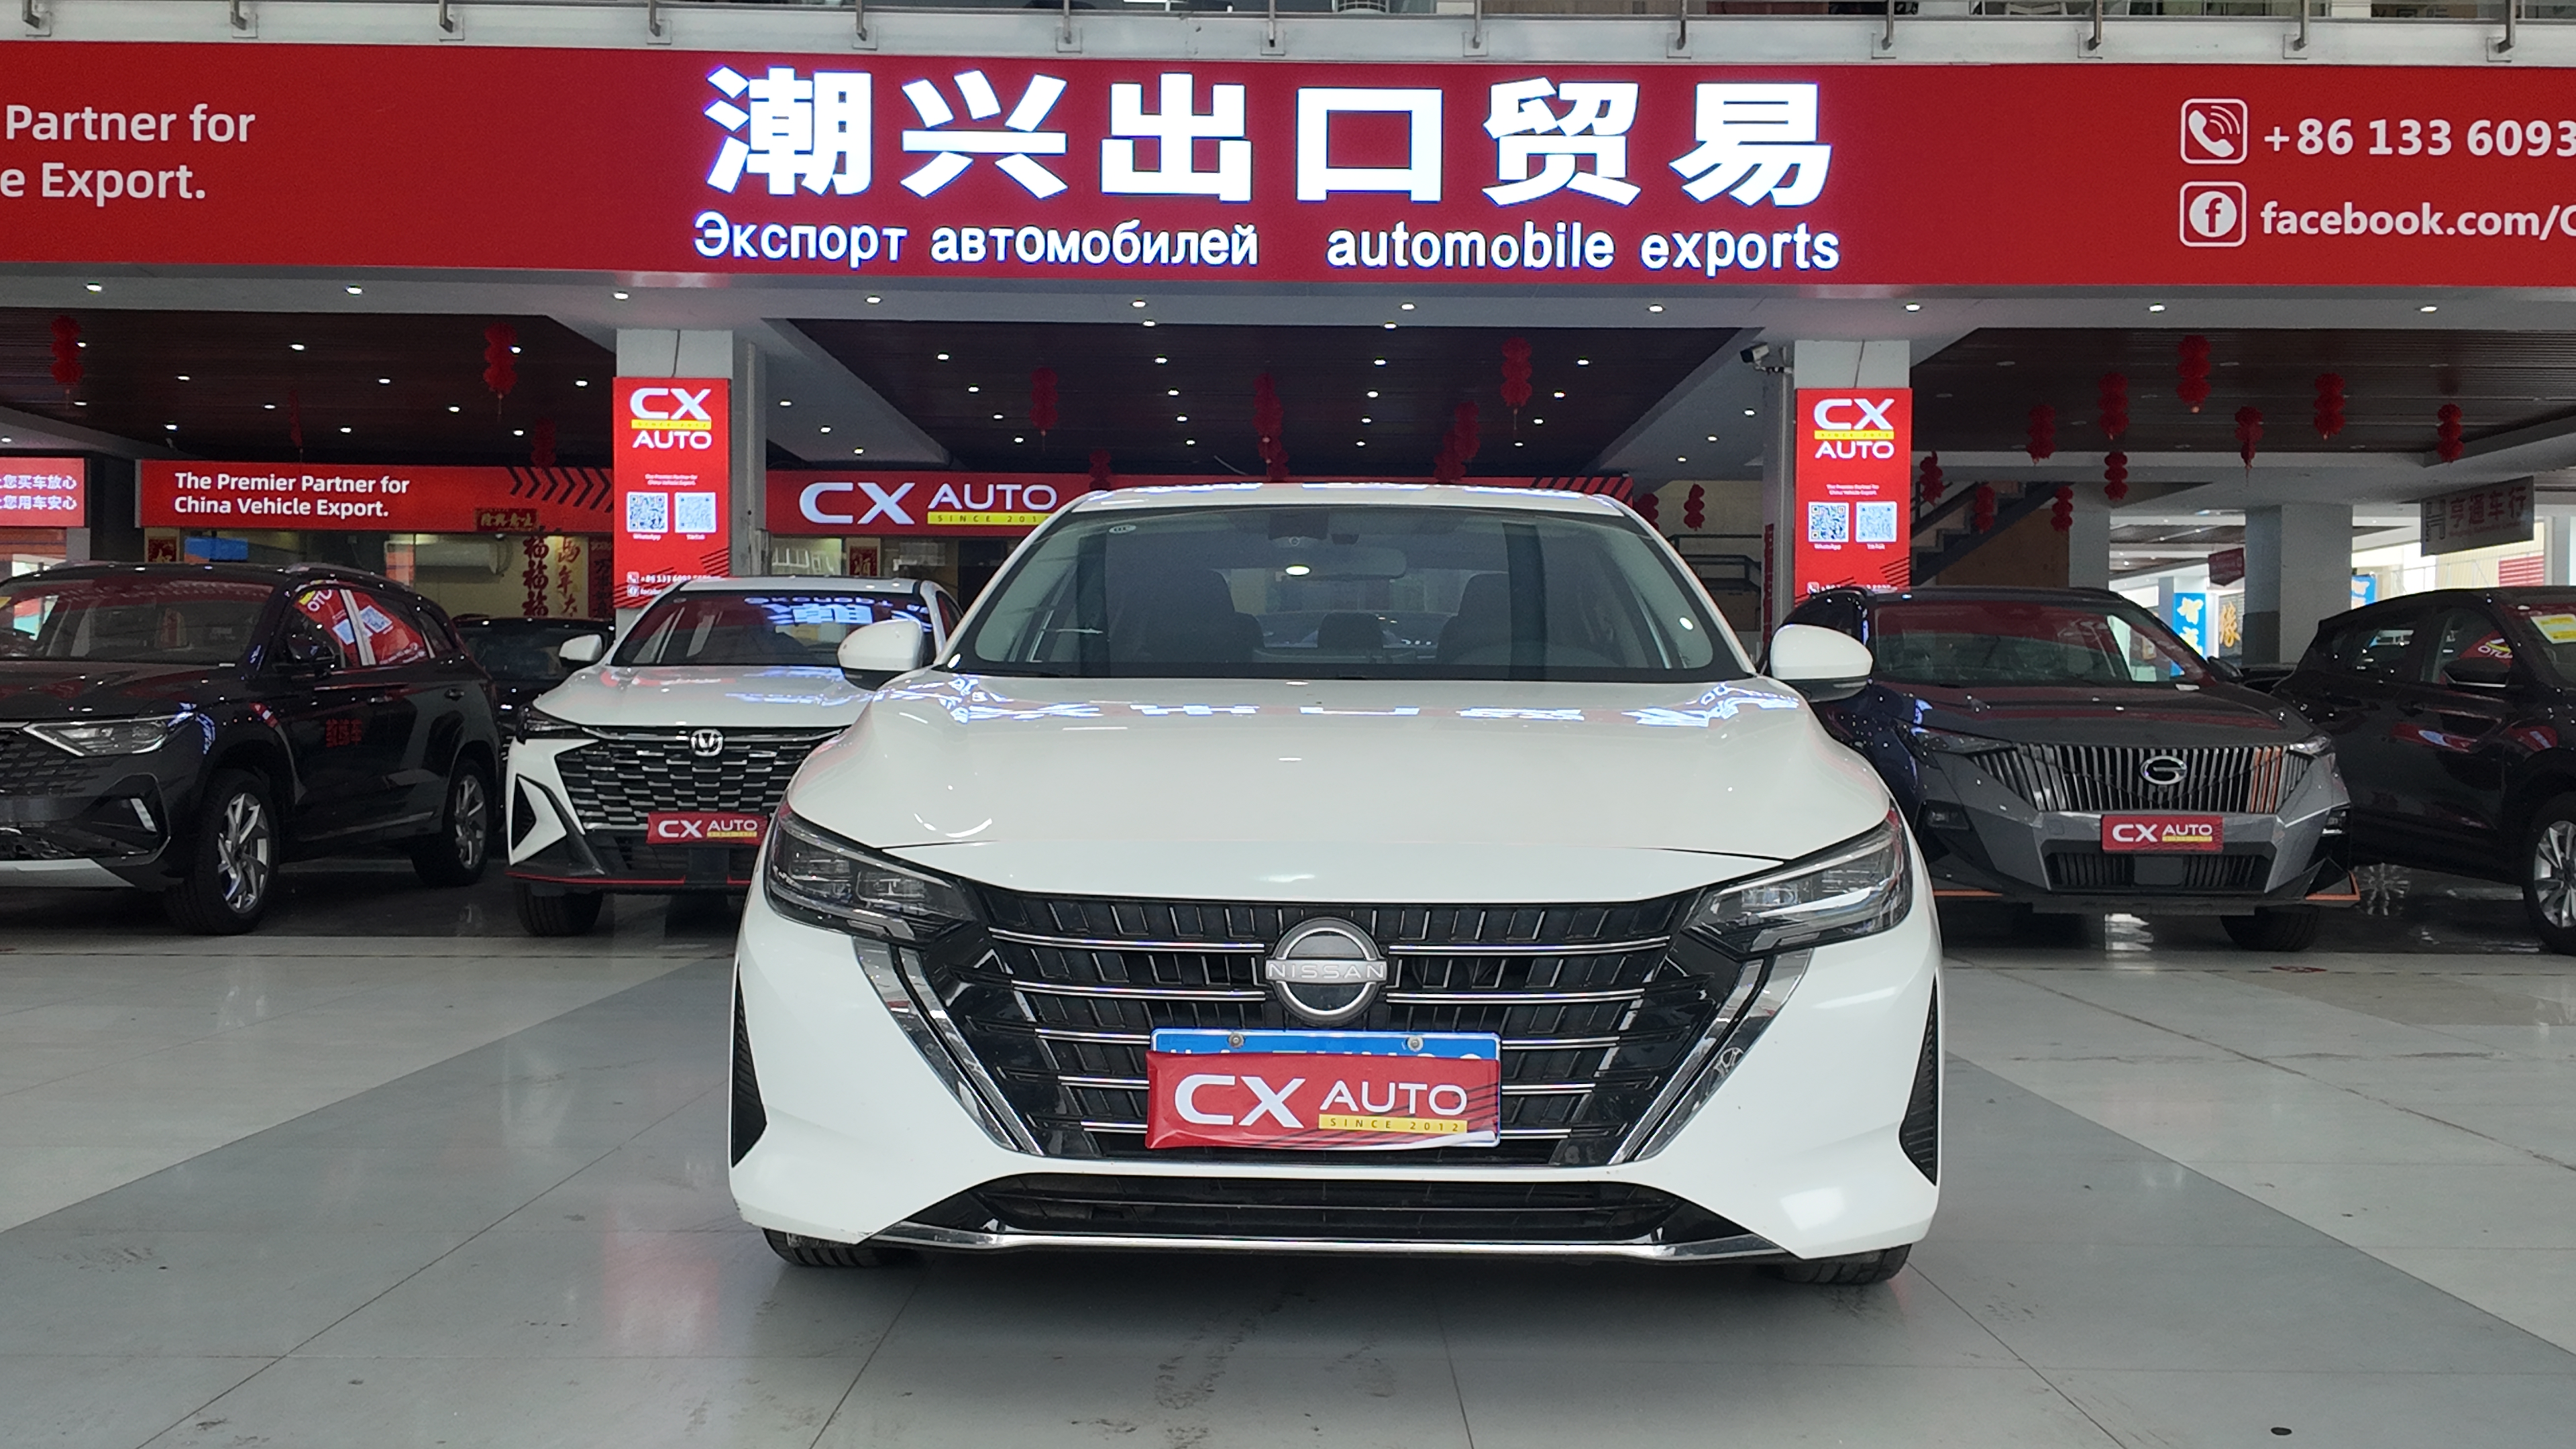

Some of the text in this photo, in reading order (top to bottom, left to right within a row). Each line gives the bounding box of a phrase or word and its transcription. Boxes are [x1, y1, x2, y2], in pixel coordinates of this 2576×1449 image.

[6, 103, 255, 142] Partner for
[703, 65, 1832, 207] 潮兴出口贸易
[2264, 118, 2576, 157] +86 133 6093
[42, 162, 205, 207] Export.
[694, 210, 1258, 268] Экспорт автомобилей
[1326, 221, 1840, 277] automobile exports
[630, 387, 711, 421] CX
[1814, 398, 1894, 430] CX
[632, 430, 712, 449] AUTO
[1815, 441, 1894, 459] AUTO
[0, 474, 77, 490] 您买车放心
[174, 472, 410, 493] The Premier Partner for
[0, 495, 77, 510] 您用车安心
[174, 496, 389, 519] China Vehicle Export.
[799, 482, 1057, 525] CX AUTO
[937, 515, 991, 523] SINCE
[658, 820, 704, 838] CX
[707, 820, 758, 831] AUTO
[2112, 824, 2212, 842] CX AUTO
[1268, 963, 1384, 979] NISSAN
[1175, 1074, 1467, 1128] CX AUTO
[1330, 1117, 1459, 1132] SINCE 2012
